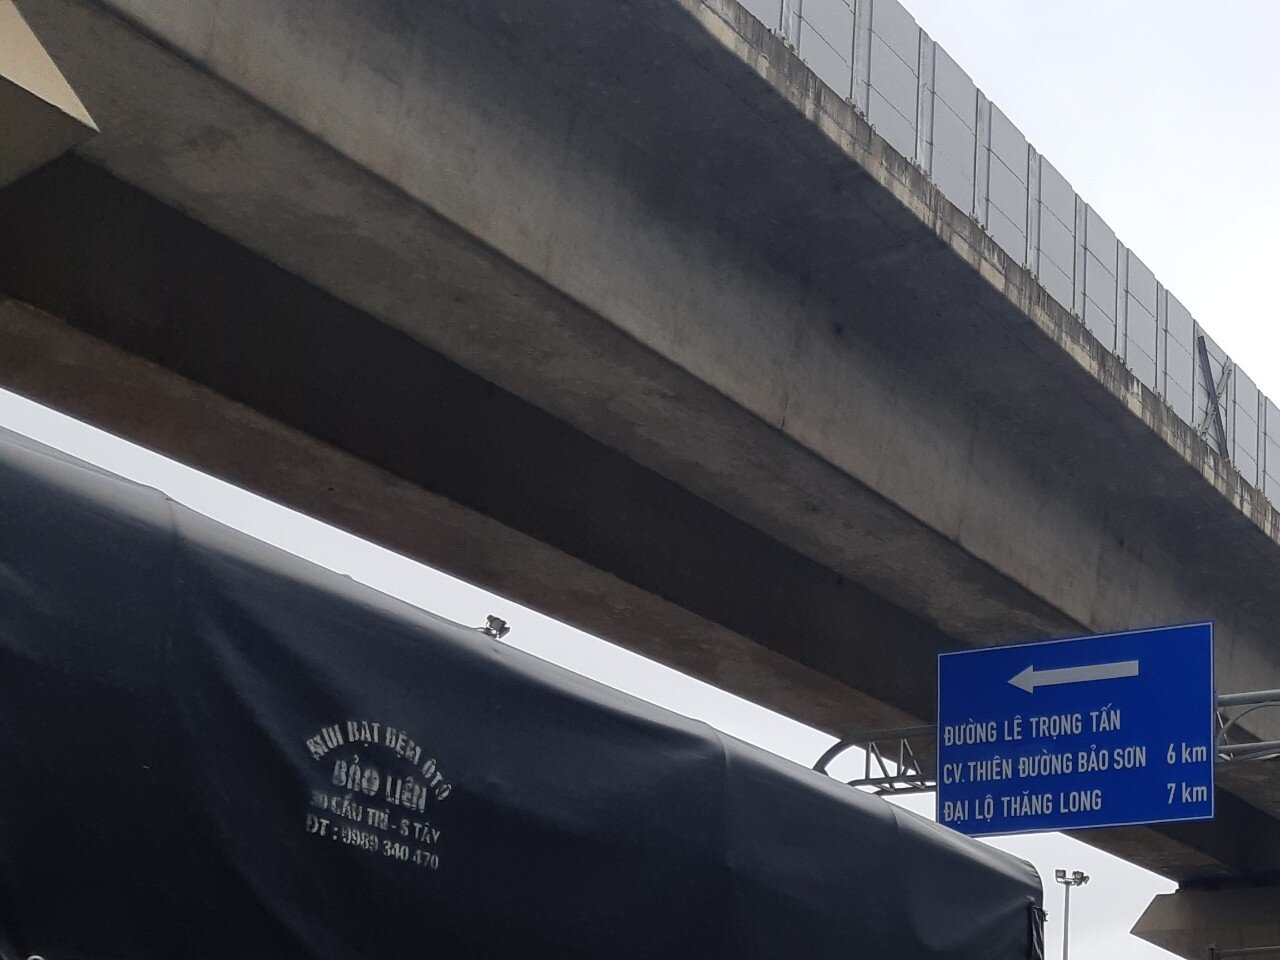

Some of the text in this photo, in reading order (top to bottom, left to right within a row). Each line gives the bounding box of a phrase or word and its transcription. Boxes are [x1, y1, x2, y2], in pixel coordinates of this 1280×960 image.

[943, 703, 1121, 746] ĐƯỜNG LÊ TRỌNG TẤN
[332, 754, 379, 796] BẢO
[970, 756, 1012, 782] THIÊN
[1018, 750, 1073, 777] ĐƯỜNG
[1078, 745, 1108, 773] BẢO
[1114, 746, 1146, 769] SƠN
[1166, 743, 1175, 764] 6
[1181, 743, 1207, 763] km
[943, 782, 1207, 824] ĐẠI LỘ THĂNG LONG 7 km
